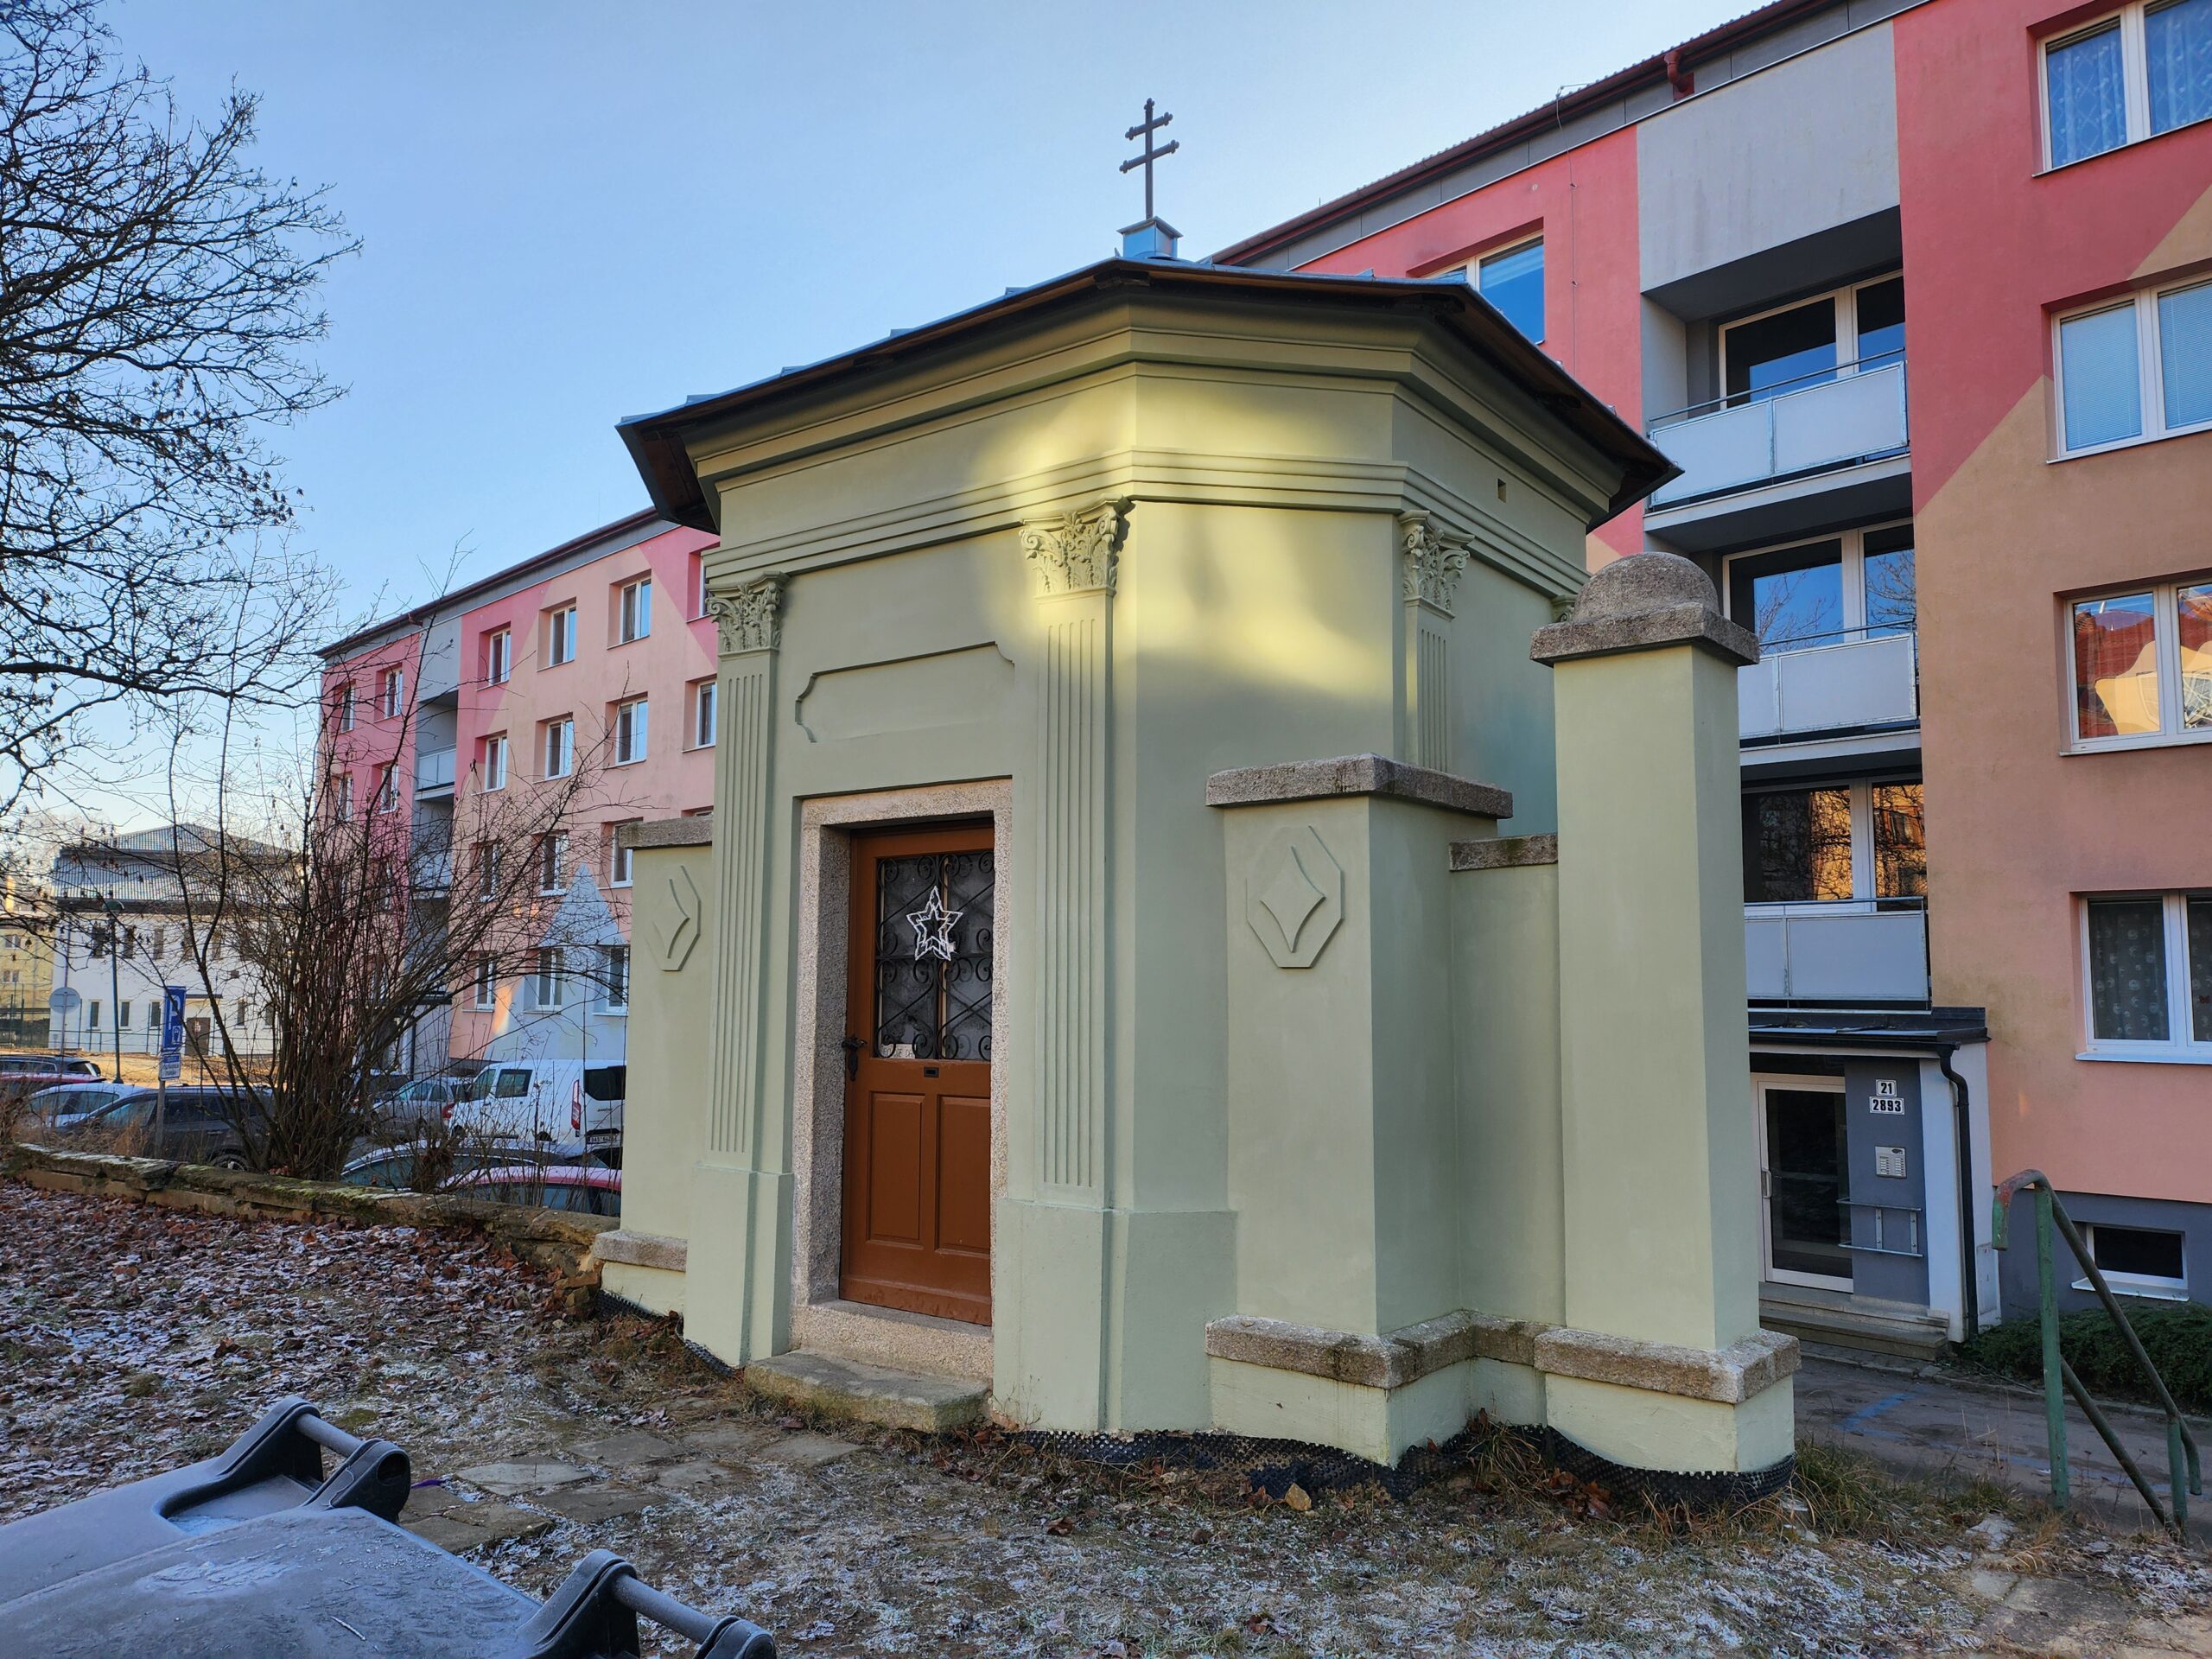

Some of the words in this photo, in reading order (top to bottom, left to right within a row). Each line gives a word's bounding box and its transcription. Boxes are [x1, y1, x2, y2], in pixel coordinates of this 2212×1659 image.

[168, 995, 181, 1031] P
[1880, 1082, 1892, 1094] 21
[1872, 1099, 1901, 1112] 2893
